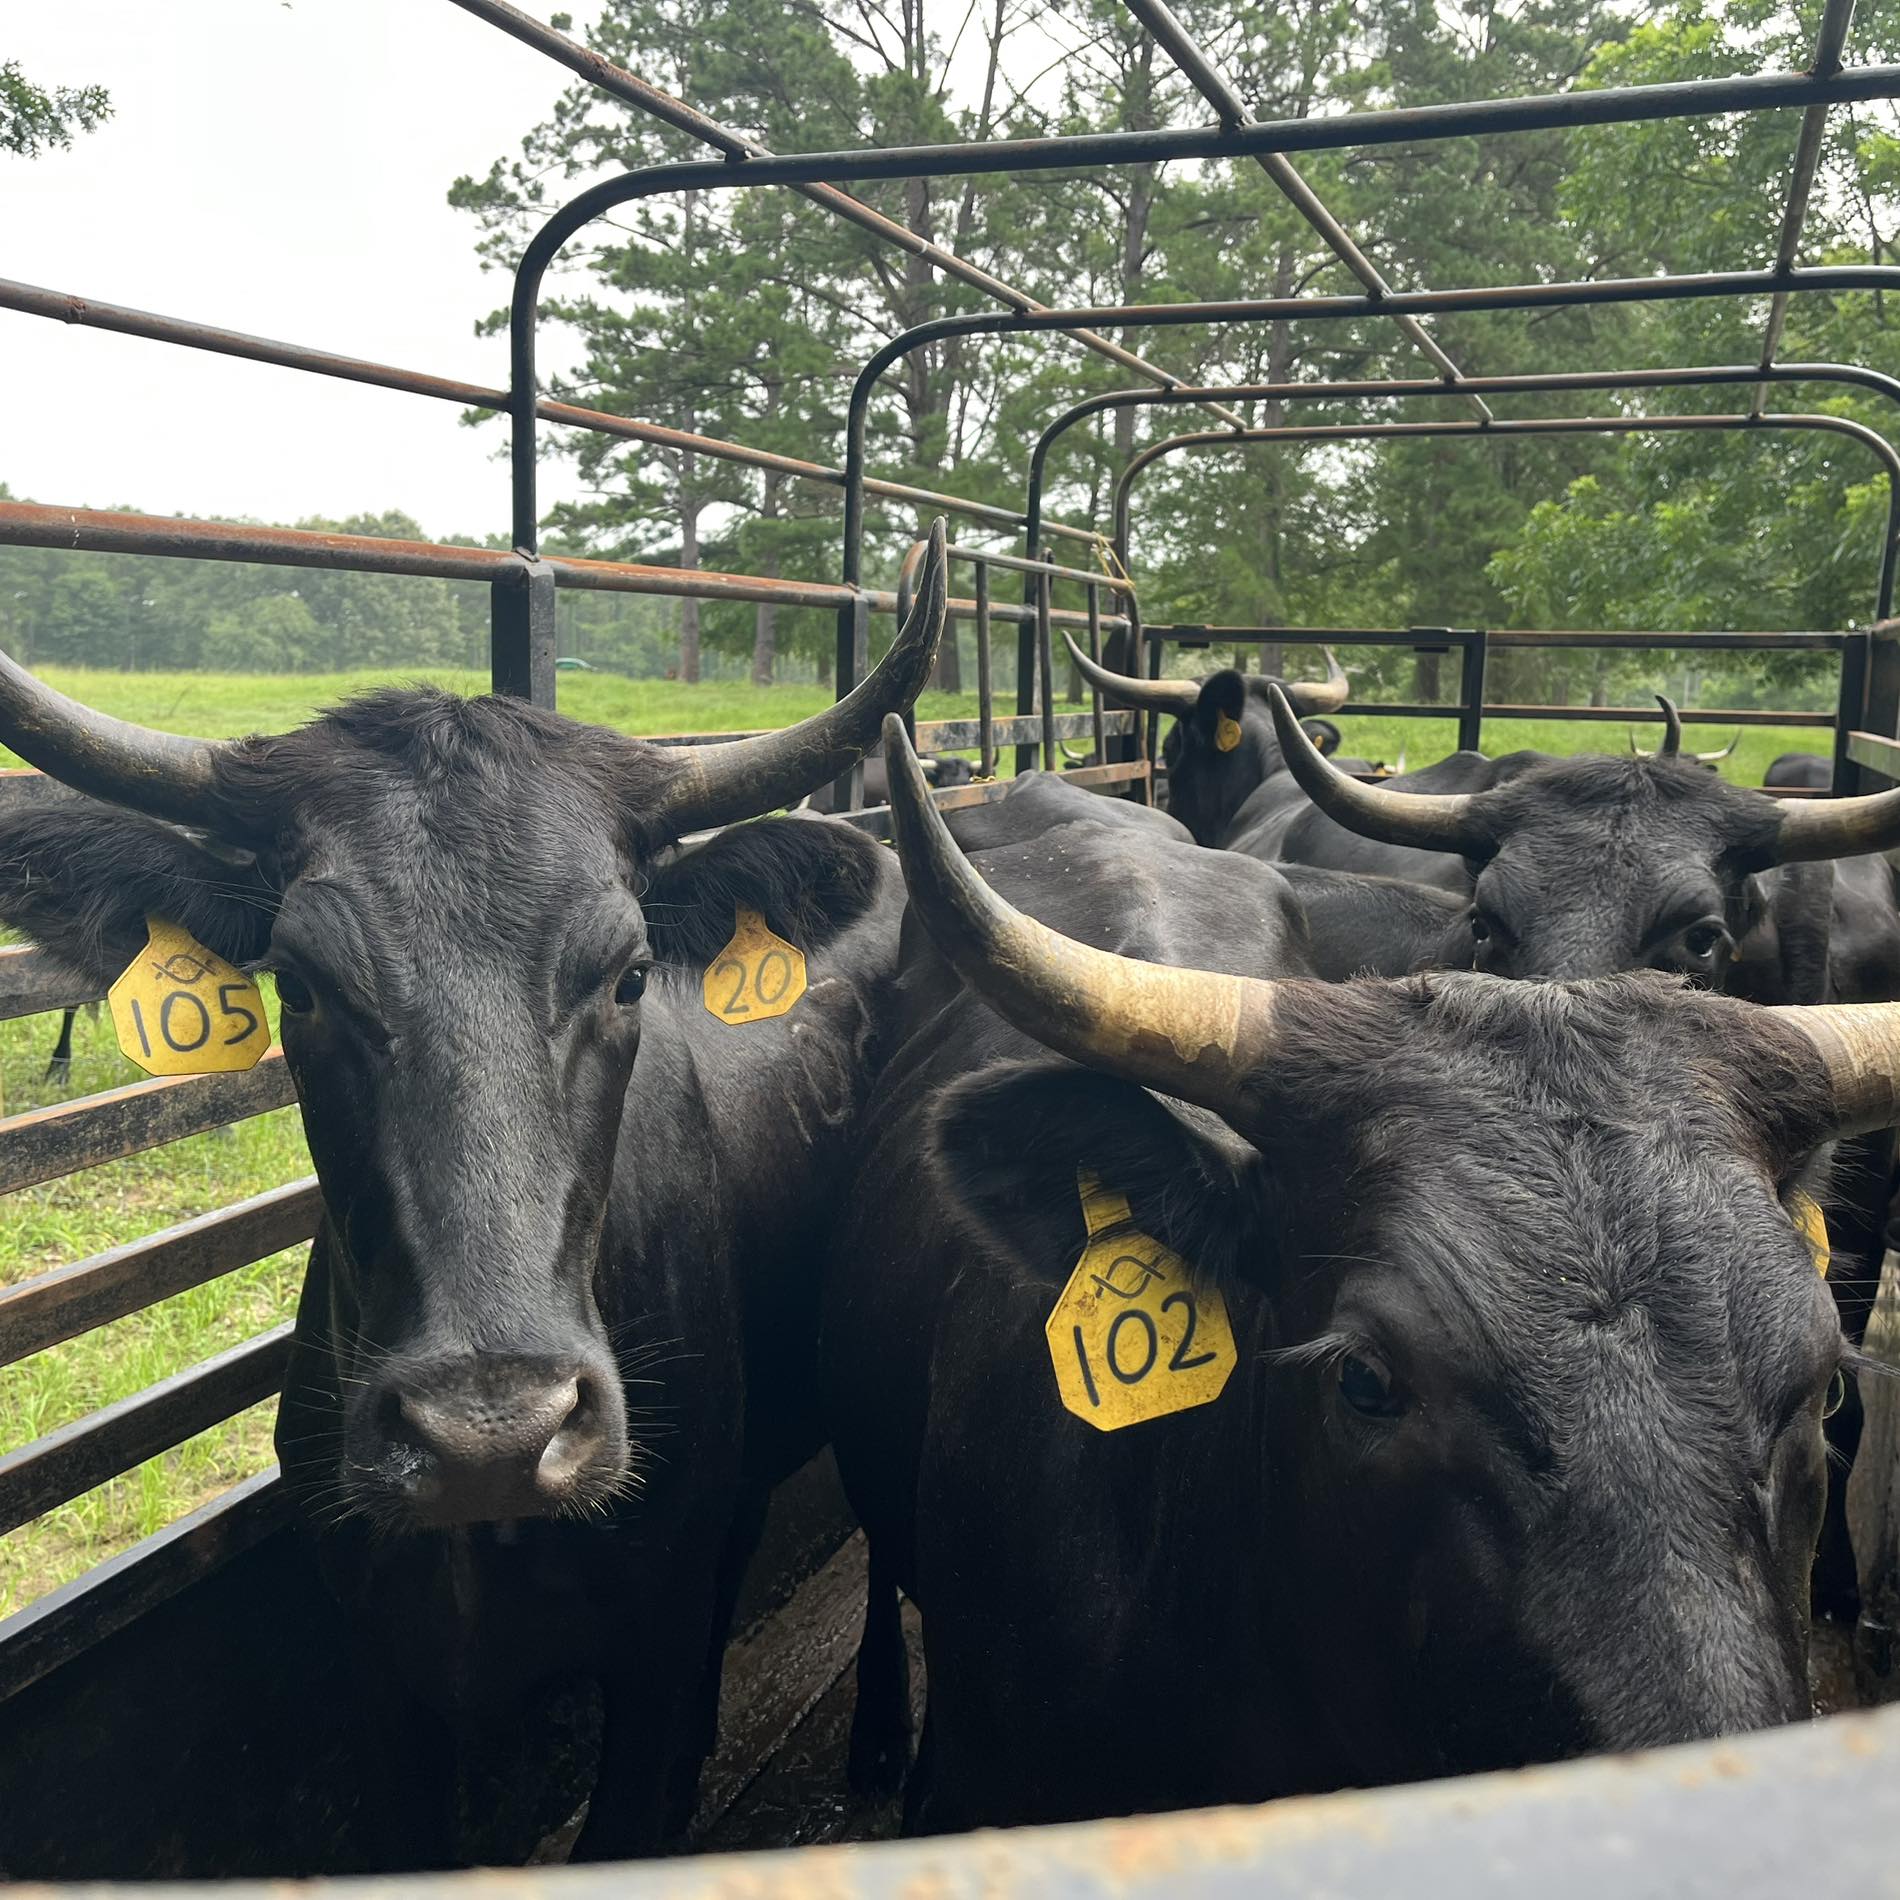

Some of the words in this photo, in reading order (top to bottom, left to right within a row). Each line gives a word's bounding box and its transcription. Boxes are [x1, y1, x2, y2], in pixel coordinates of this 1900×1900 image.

[715, 951, 791, 1014] 20
[131, 984, 258, 1057] 105
[1073, 1291, 1217, 1407] 102
